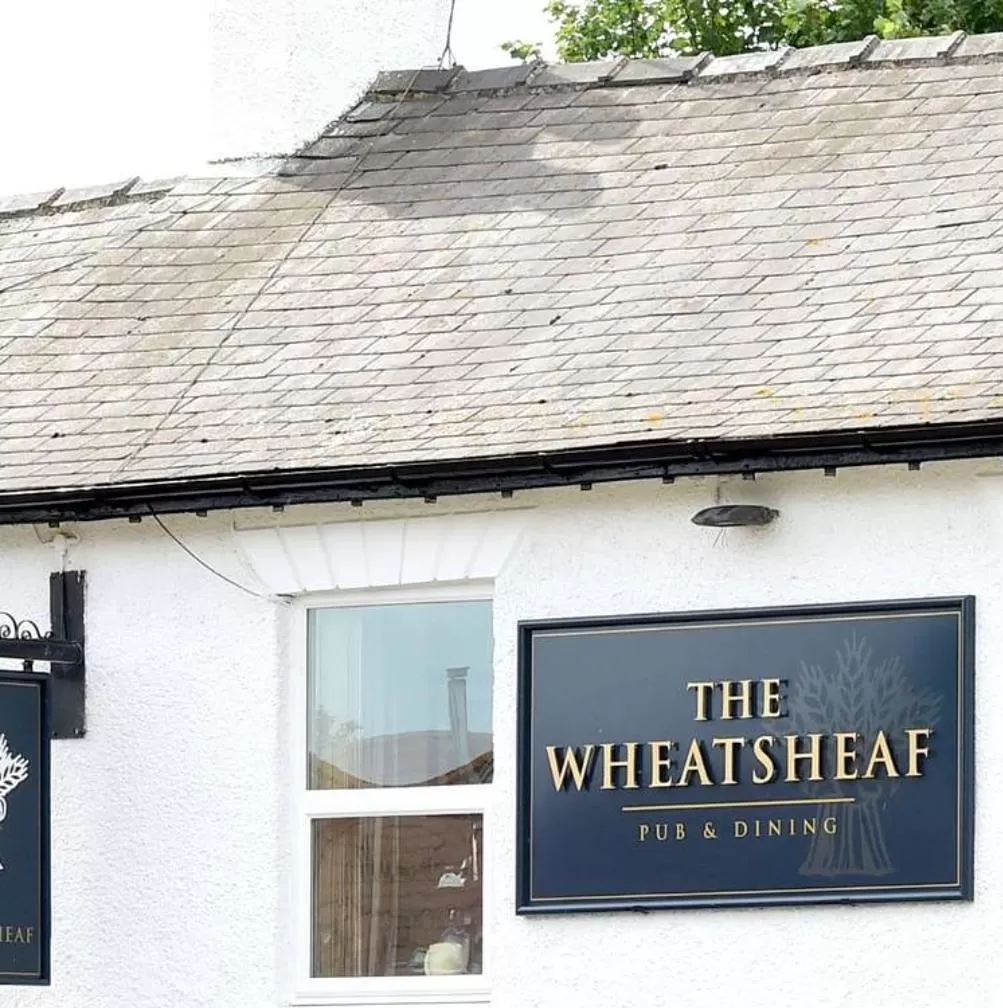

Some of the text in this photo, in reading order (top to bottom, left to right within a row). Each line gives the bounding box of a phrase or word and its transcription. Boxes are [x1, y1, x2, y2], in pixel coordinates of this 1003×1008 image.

[687, 677, 784, 721] THE
[546, 728, 935, 793] WHEATSHEAF
[639, 816, 839, 842] PUB & DINING
